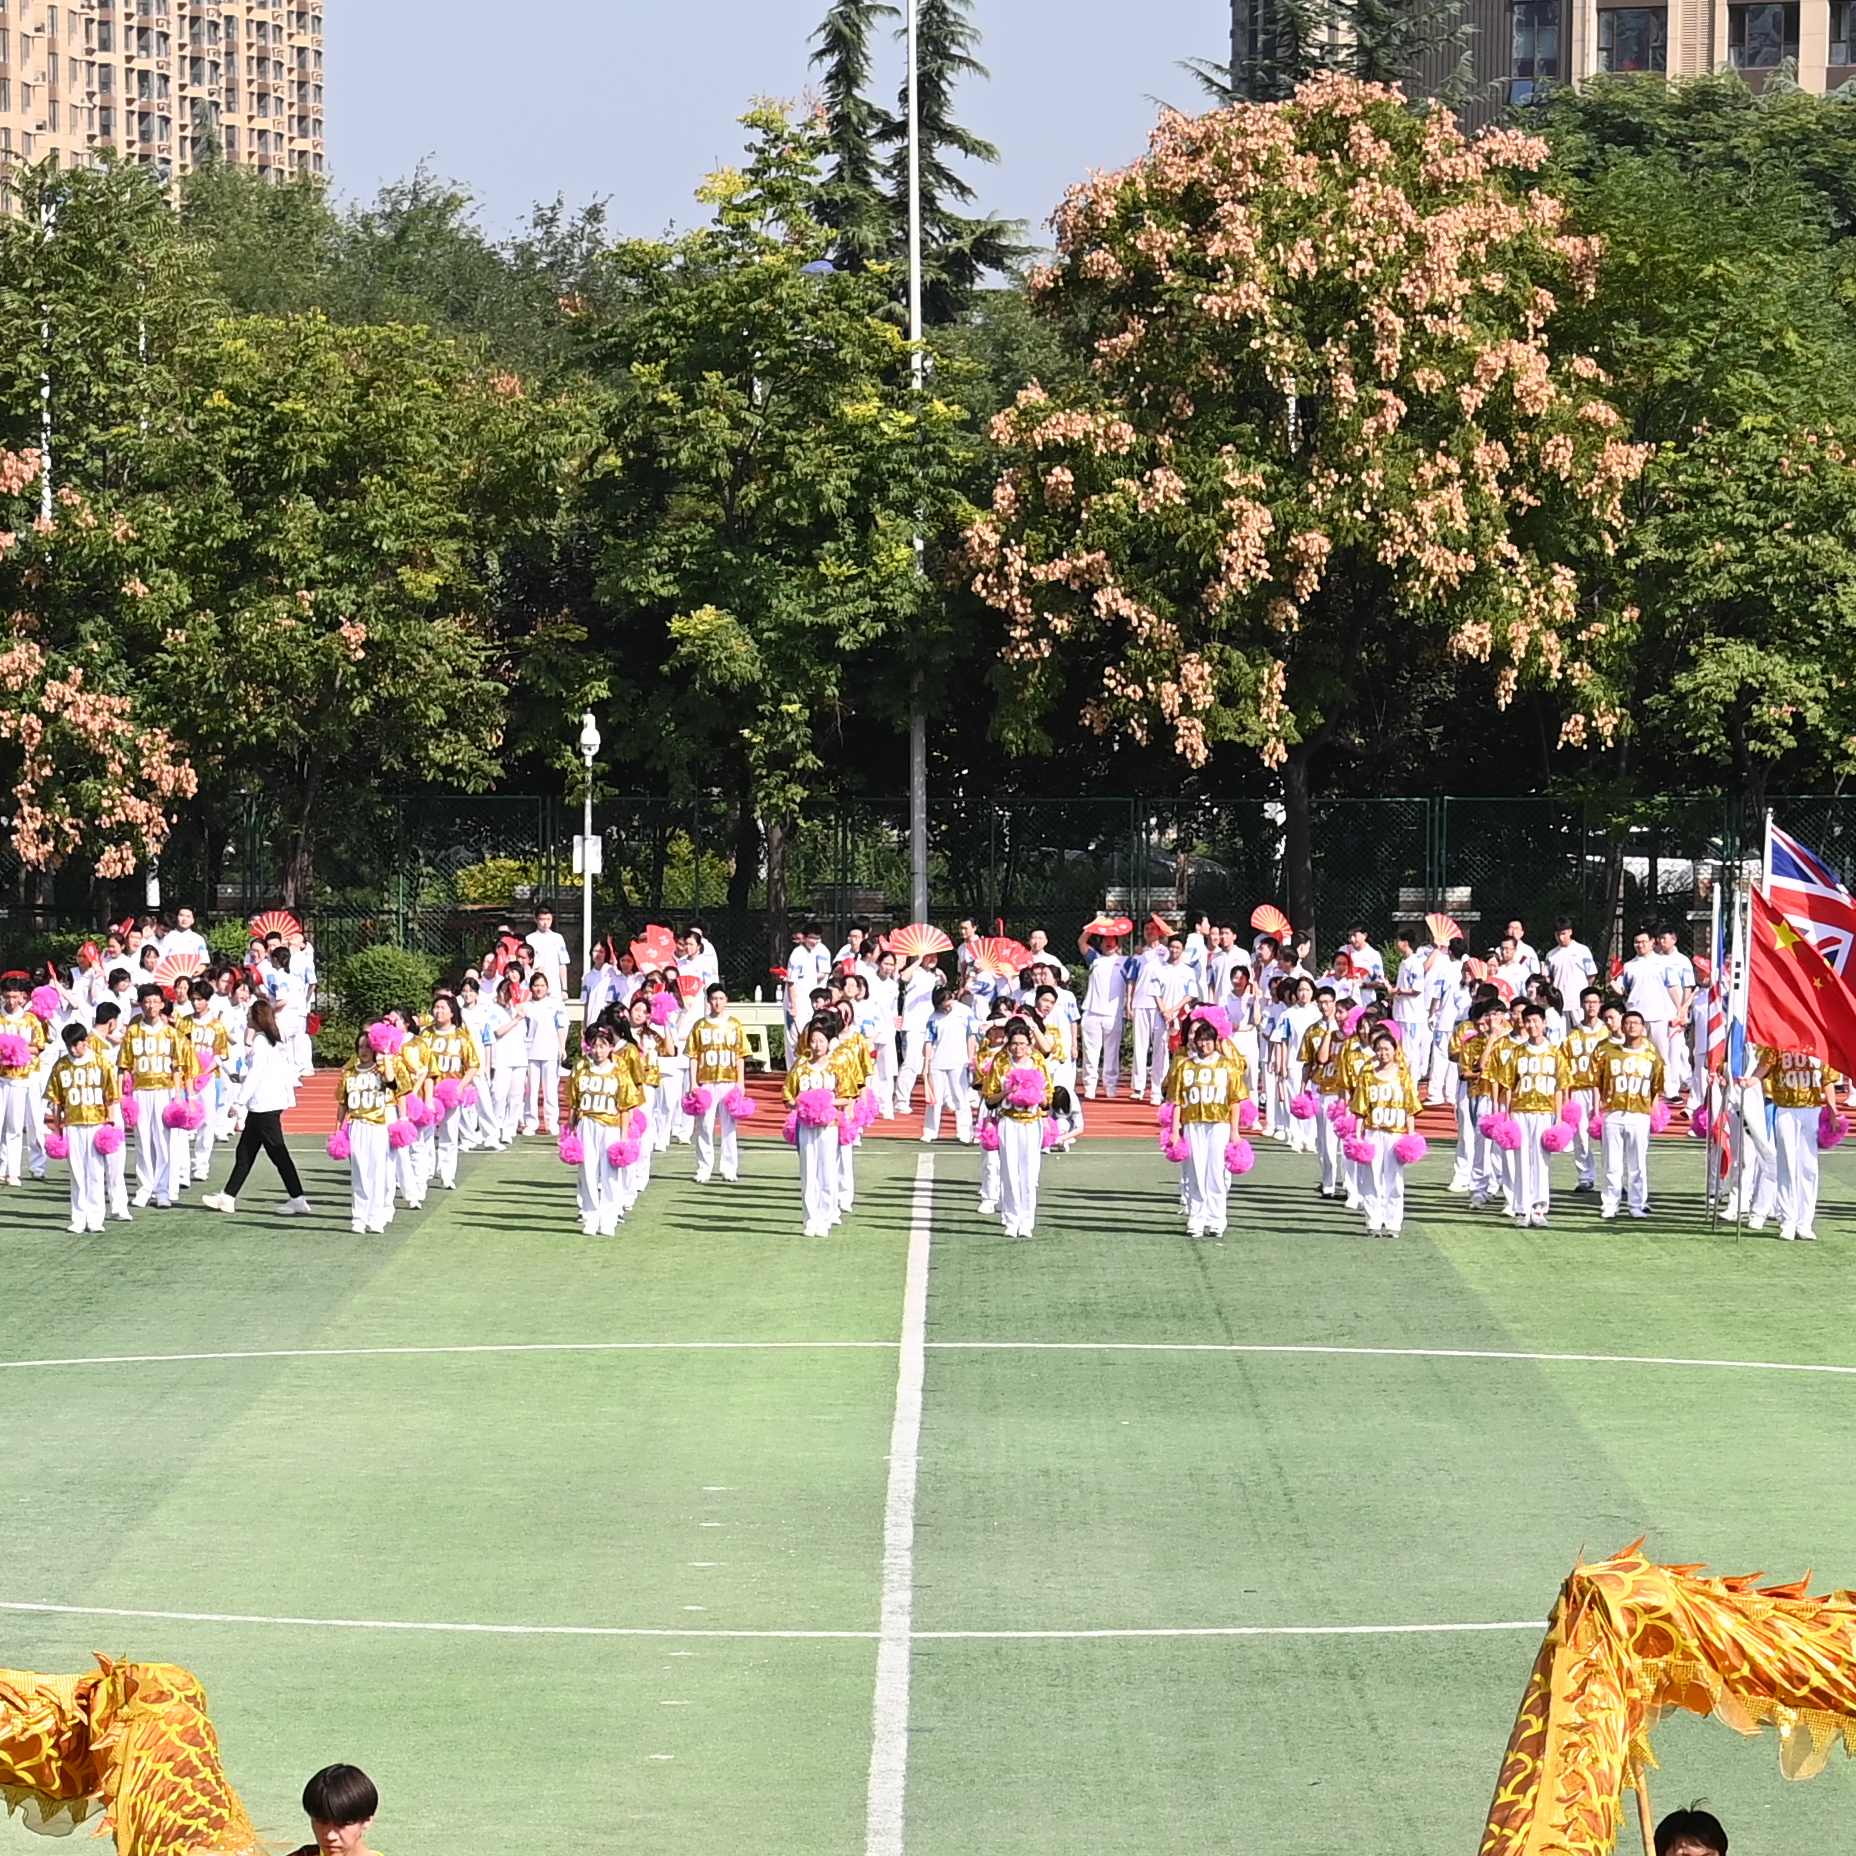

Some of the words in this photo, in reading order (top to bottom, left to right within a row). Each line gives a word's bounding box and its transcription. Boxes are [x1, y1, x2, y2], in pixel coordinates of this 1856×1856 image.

[132, 1037, 171, 1055] BON
[701, 1028, 736, 1046] BON
[1571, 1038, 1598, 1056] BO
[1517, 1056, 1556, 1075] BON
[1611, 1056, 1652, 1077] BON
[60, 1068, 101, 1088] BON
[579, 1076, 618, 1094] BON
[799, 1073, 836, 1092] BON
[1183, 1068, 1228, 1087] BON
[68, 1086, 103, 1105] OUR
[1369, 1084, 1404, 1102] BON
[1372, 1107, 1405, 1127] OUR
